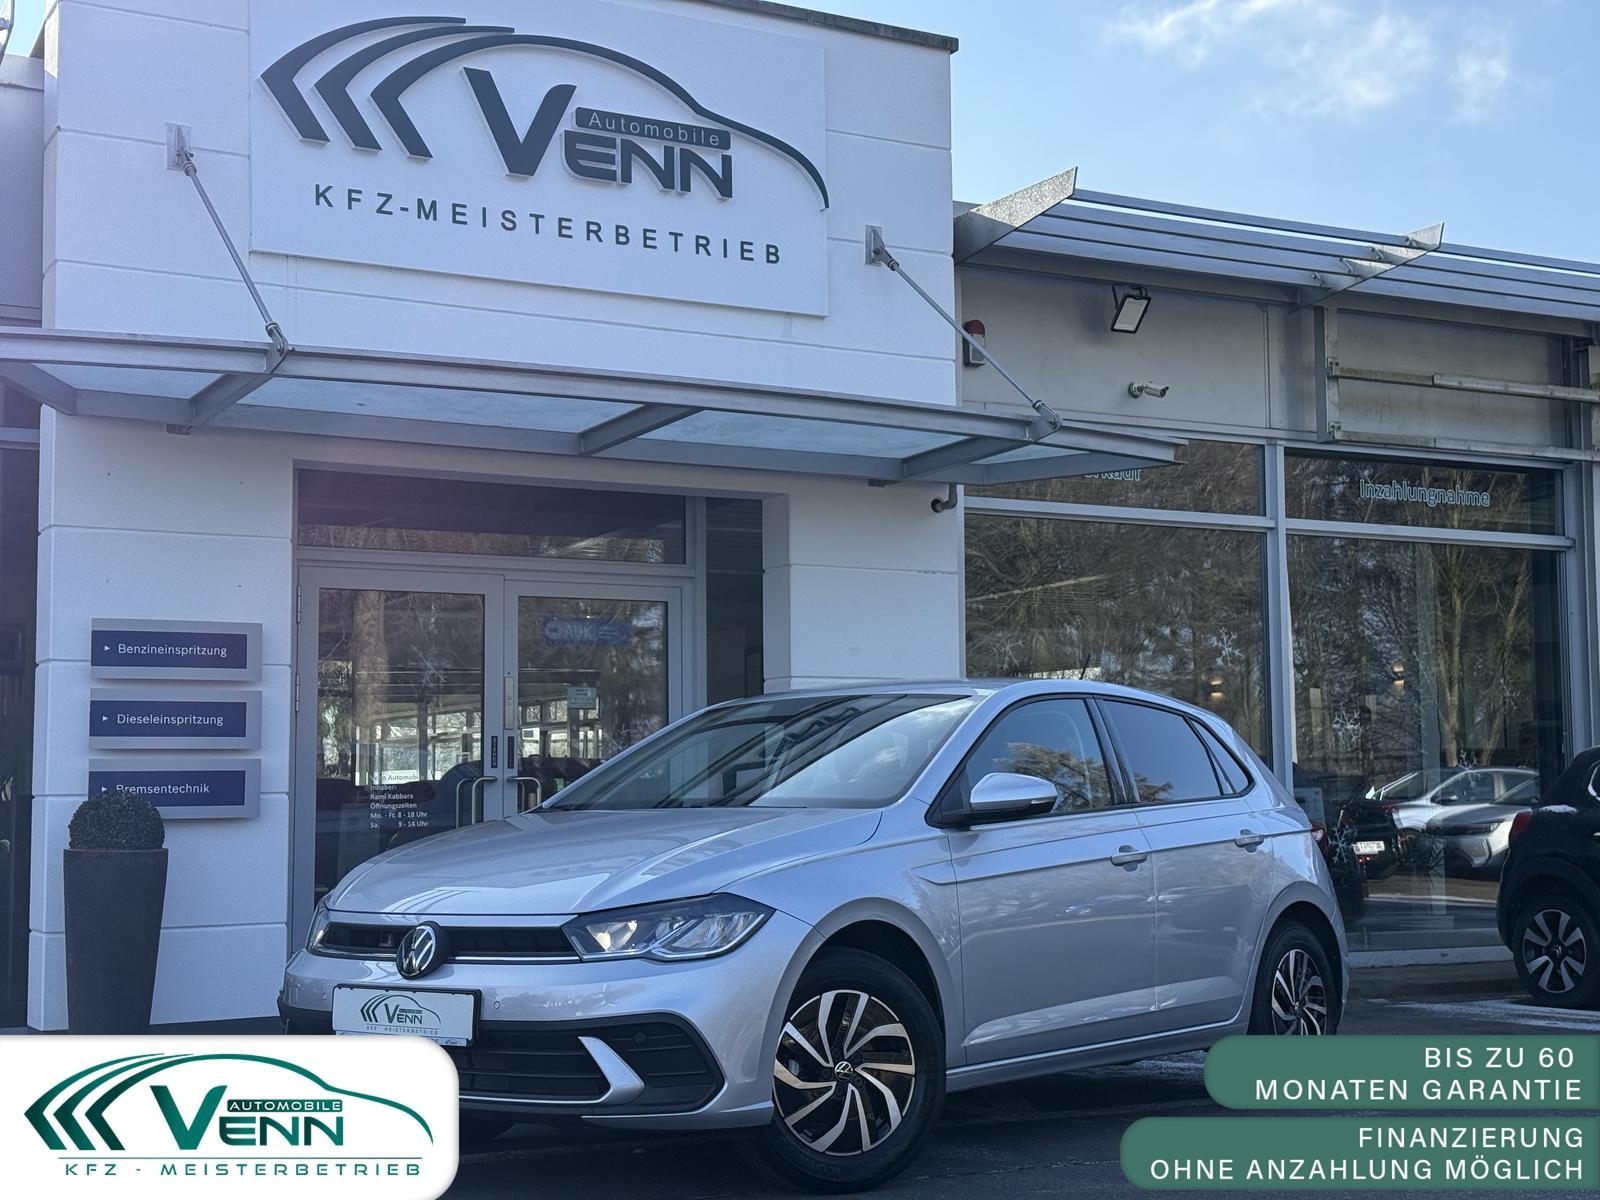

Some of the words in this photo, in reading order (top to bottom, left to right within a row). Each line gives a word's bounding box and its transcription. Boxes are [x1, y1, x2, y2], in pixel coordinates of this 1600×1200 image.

[588, 112, 721, 147] Automobile
[314, 184, 781, 265] KFZ-MEISTERBETRIEB
[1359, 478, 1491, 507] Inzahlungnahme
[118, 643, 227, 657] Benzineinspritzung
[116, 713, 224, 726] Dieseleinspritzung
[116, 784, 210, 794] Bremsentechnik
[416, 810, 428, 818] Uhr
